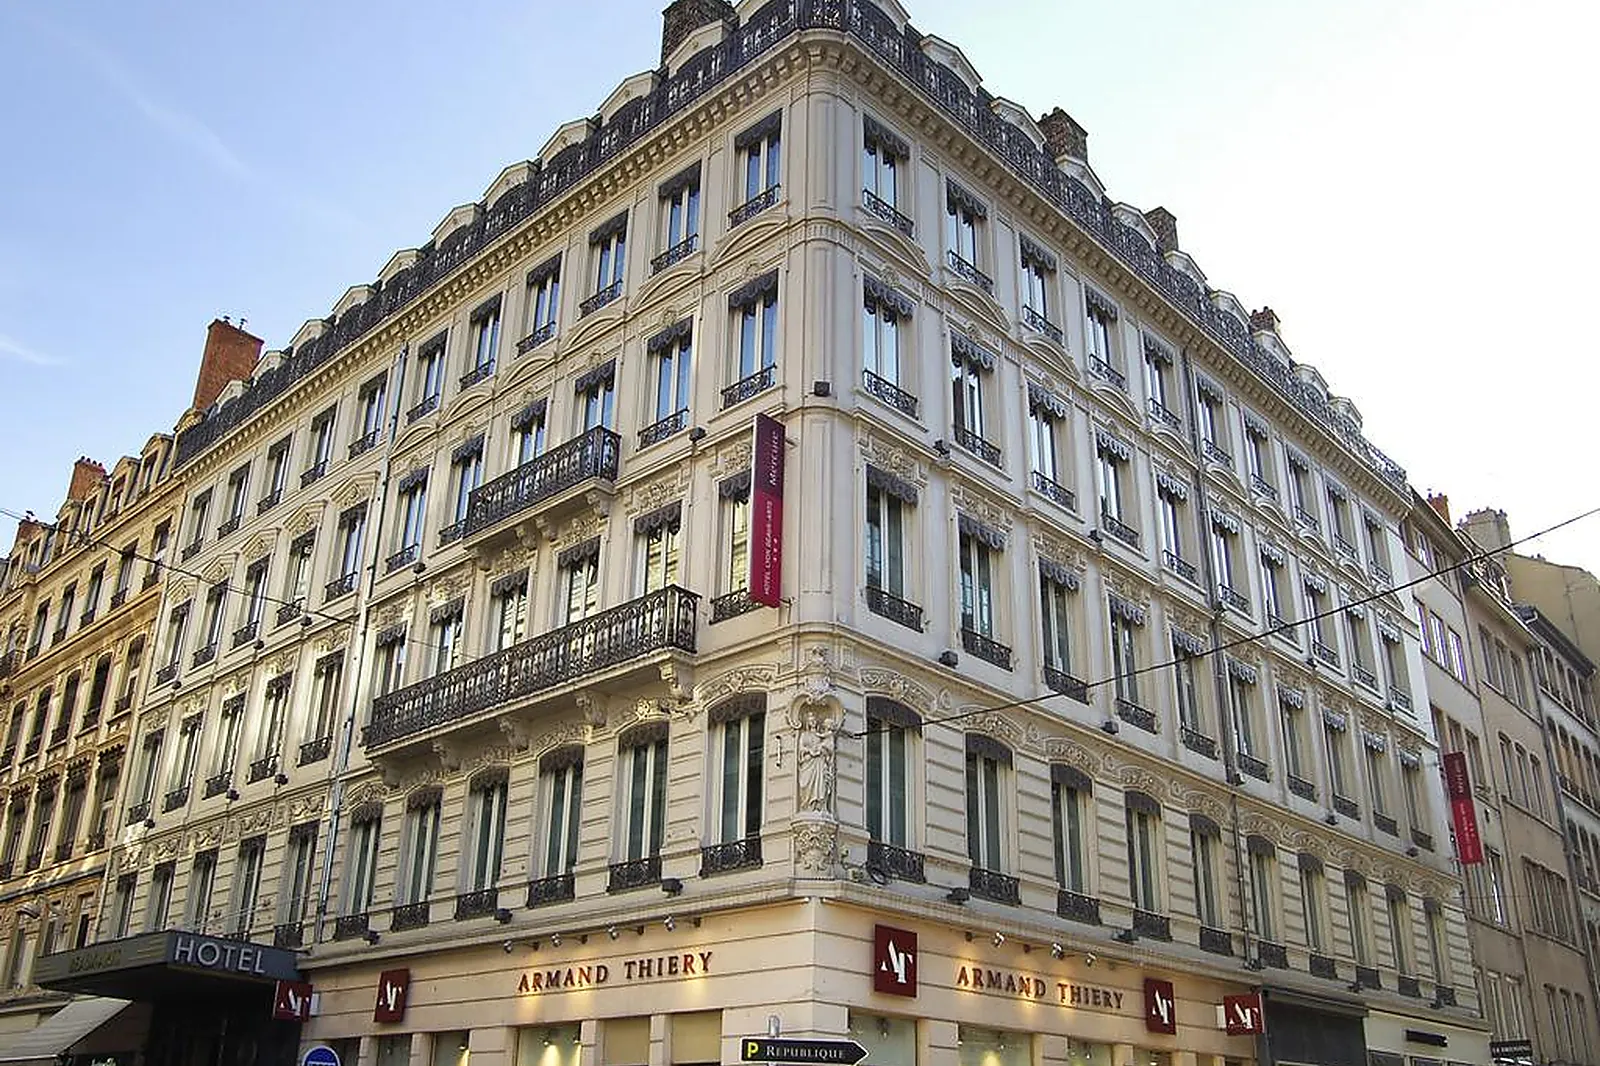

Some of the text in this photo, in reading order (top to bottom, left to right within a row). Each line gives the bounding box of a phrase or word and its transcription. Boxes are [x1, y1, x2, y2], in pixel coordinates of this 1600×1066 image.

[174, 936, 266, 974] HOTEL
[517, 951, 713, 993] ARMAND THIERY
[956, 966, 1124, 1009] ARMAND THIERY
[747, 1041, 759, 1058] P
